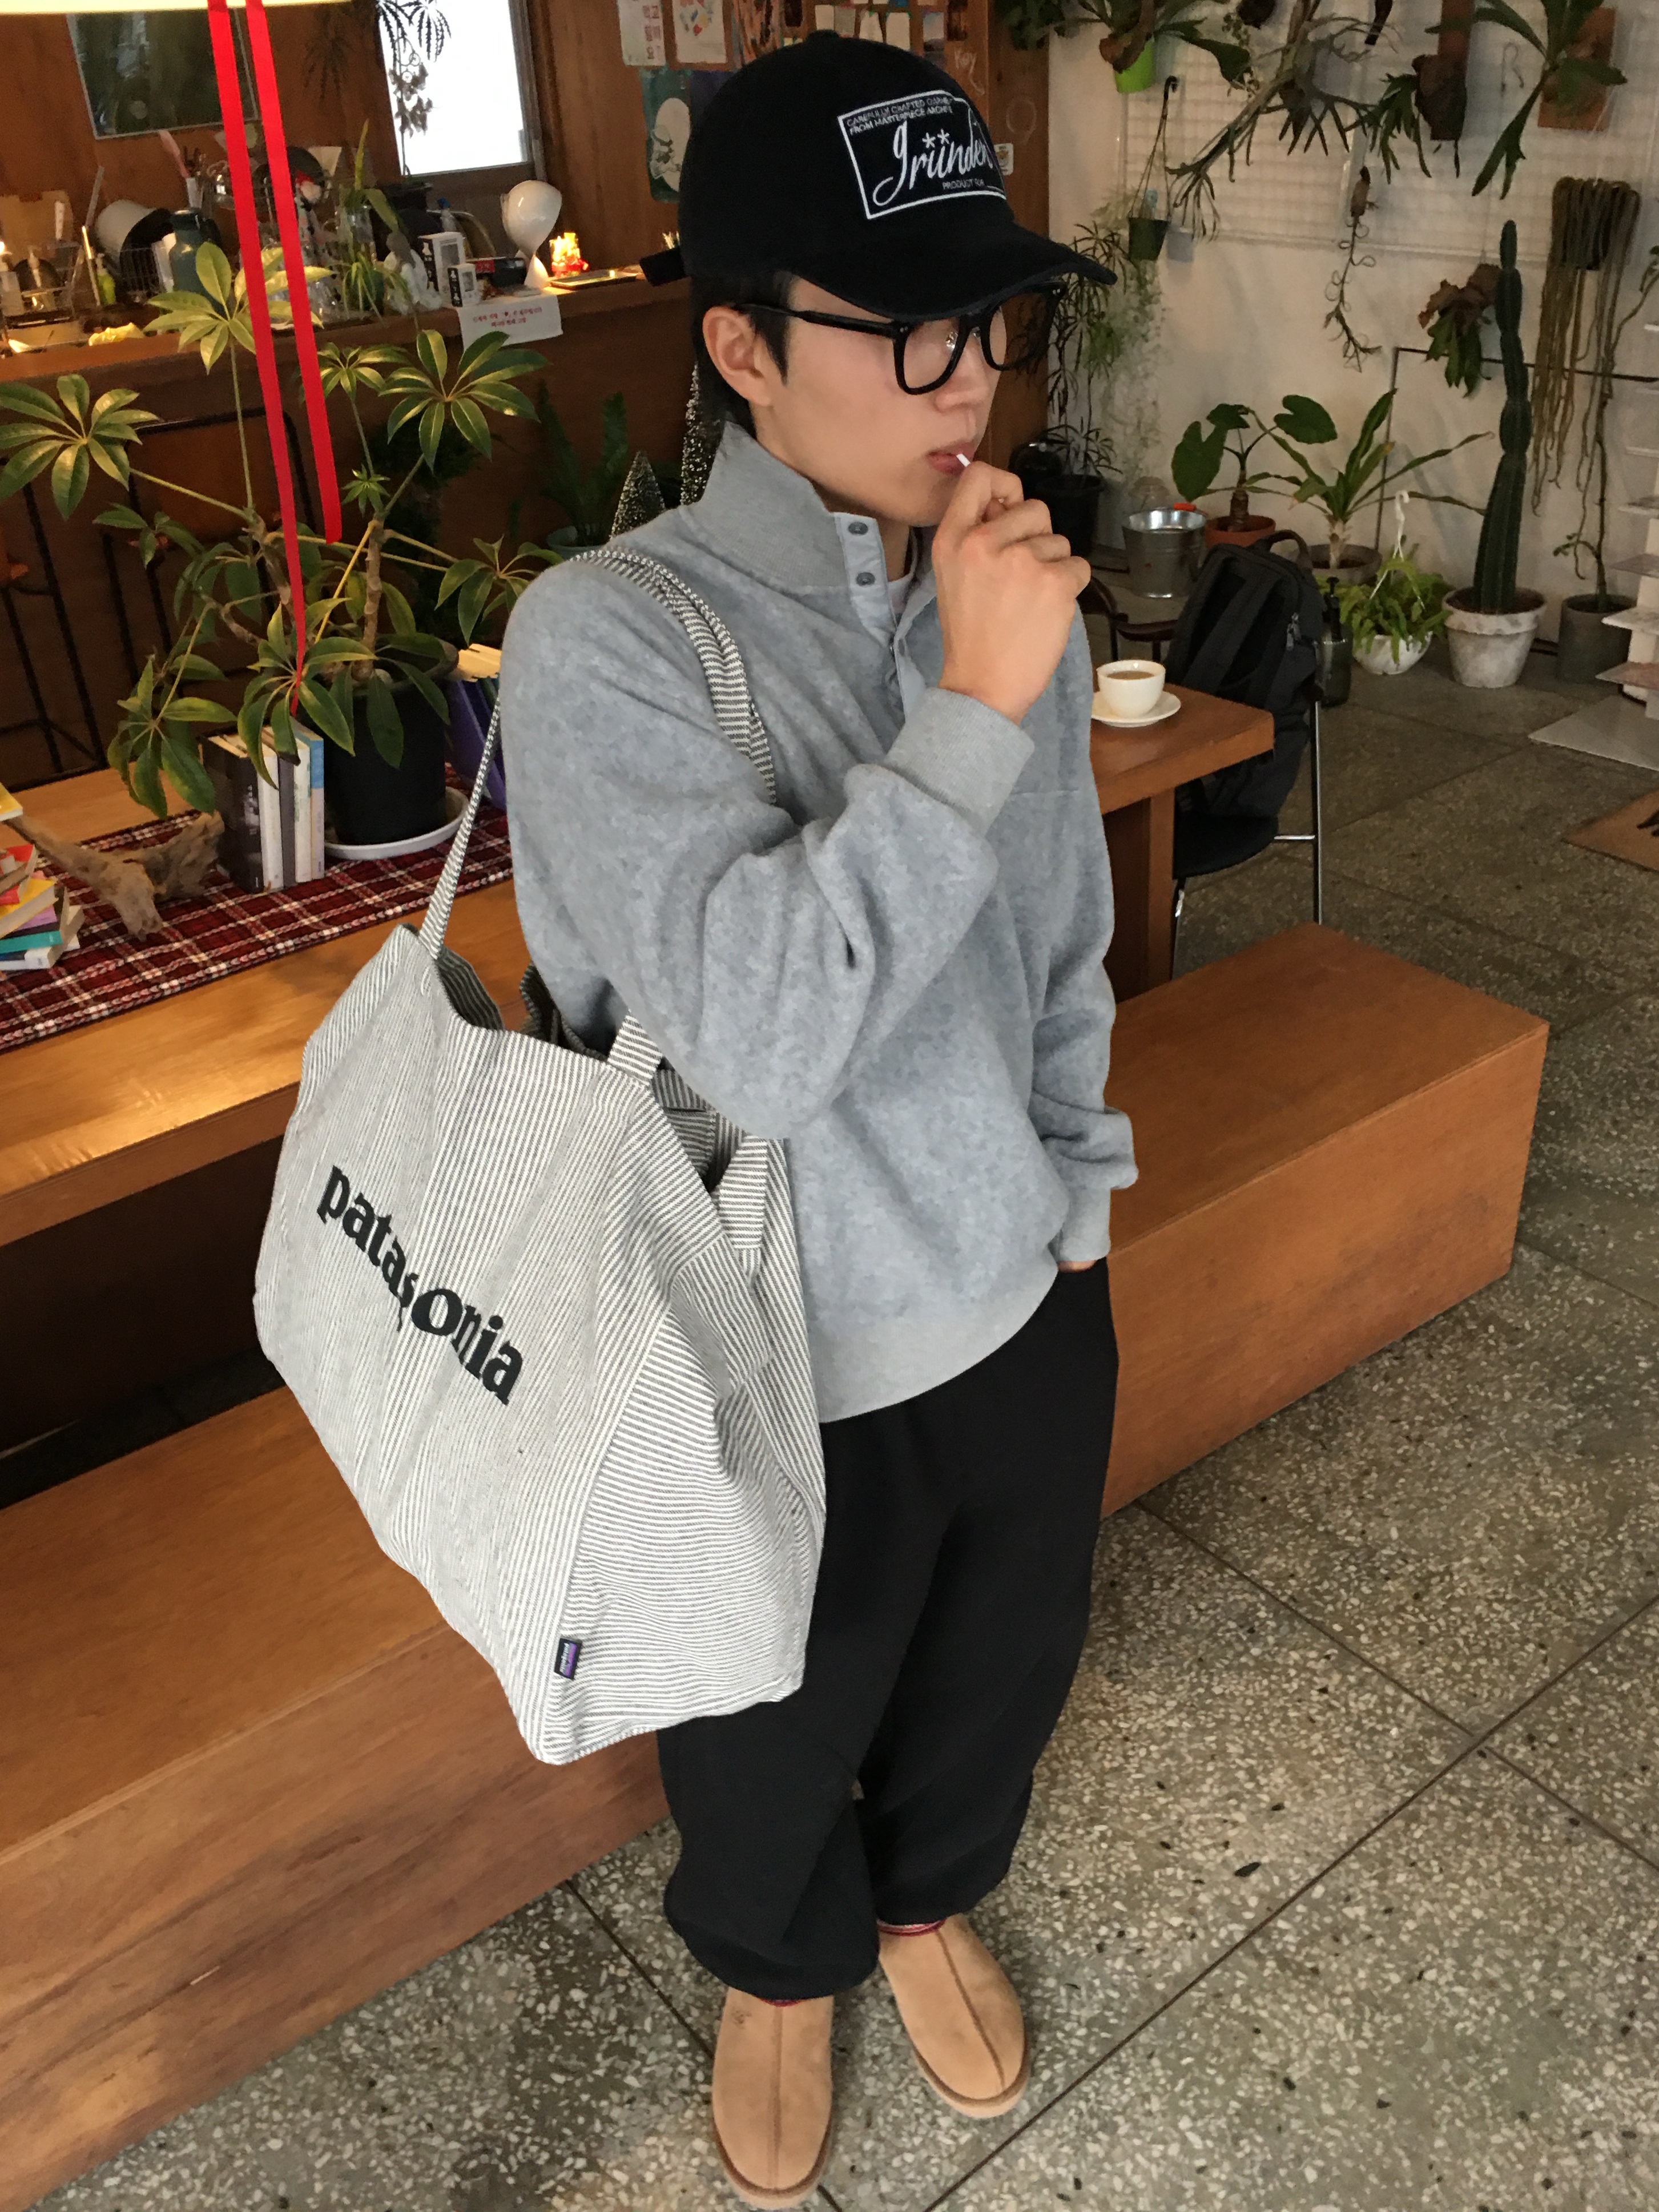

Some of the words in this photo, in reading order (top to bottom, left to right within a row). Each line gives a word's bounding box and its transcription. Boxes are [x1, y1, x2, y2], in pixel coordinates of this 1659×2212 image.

[891, 99, 925, 114] CRAFTED
[850, 121, 874, 136] FROM
[874, 108, 926, 127] MASTERPIECE
